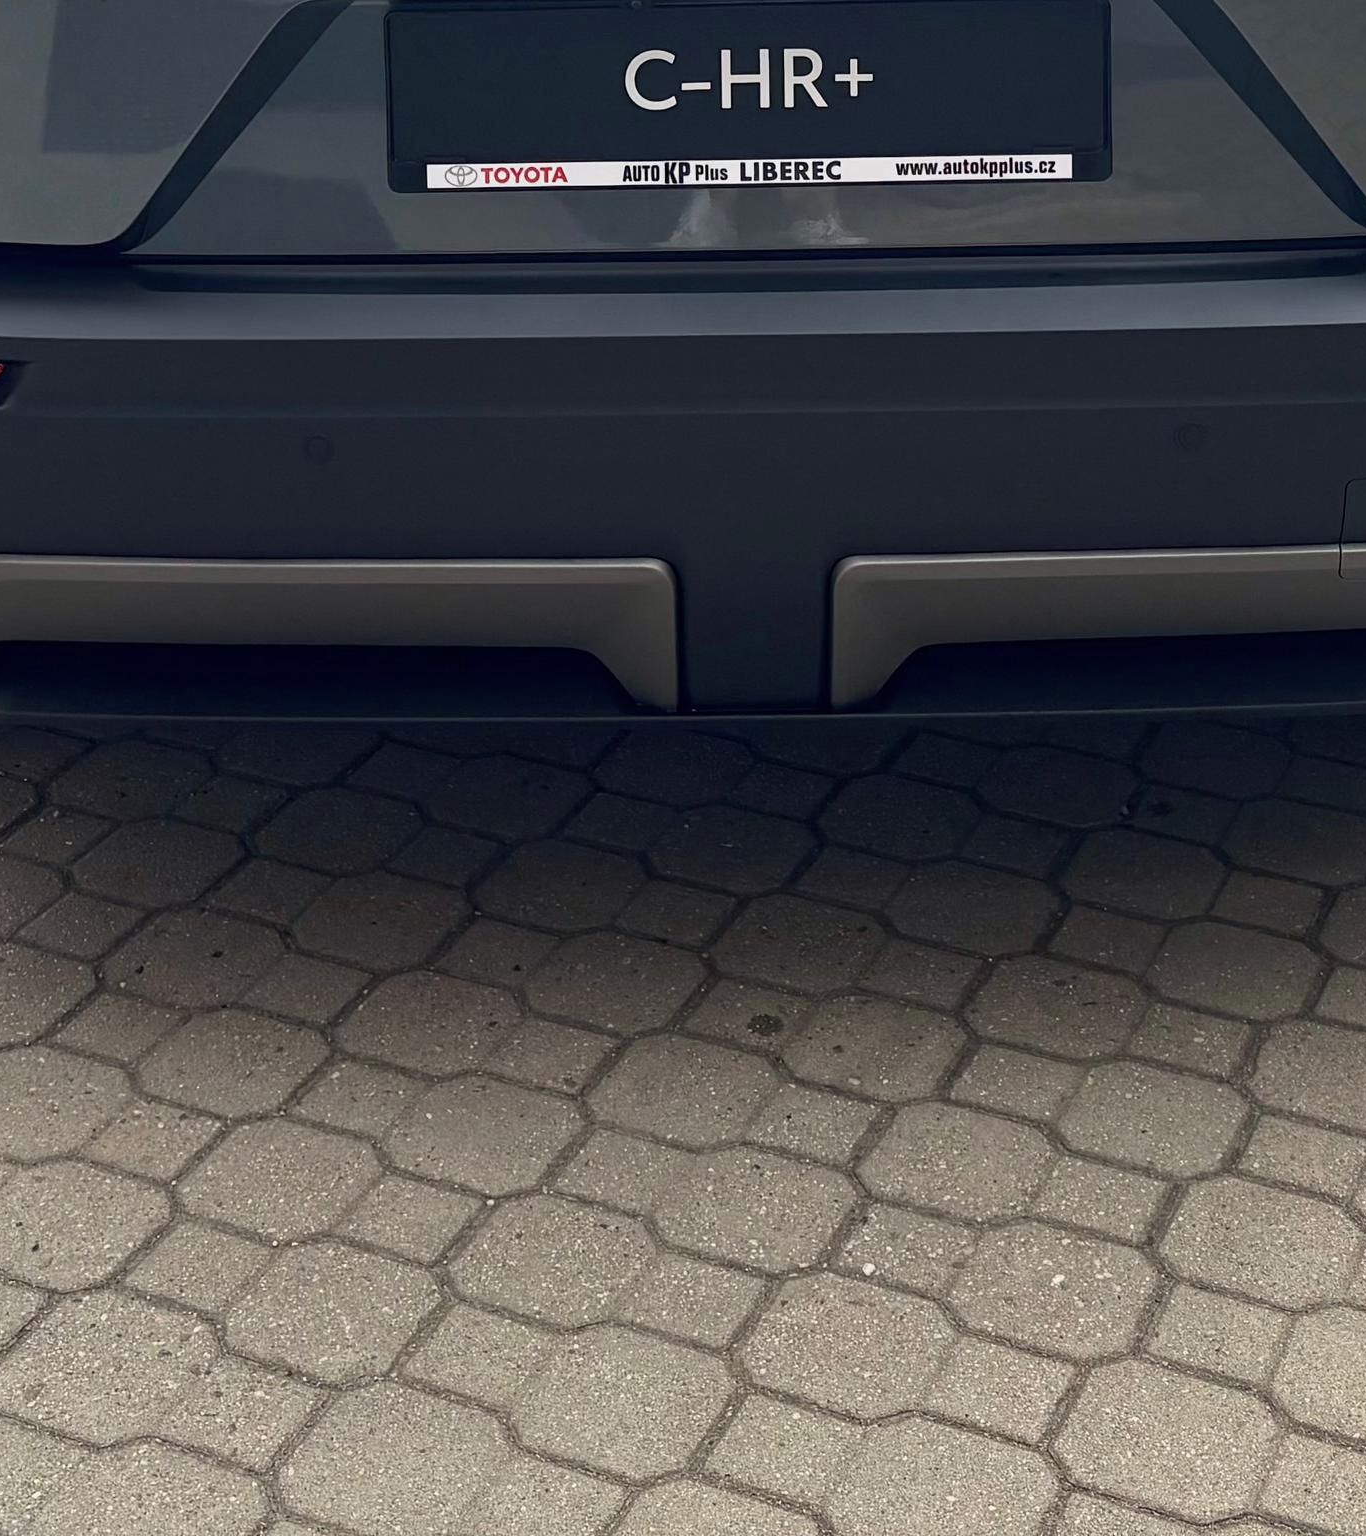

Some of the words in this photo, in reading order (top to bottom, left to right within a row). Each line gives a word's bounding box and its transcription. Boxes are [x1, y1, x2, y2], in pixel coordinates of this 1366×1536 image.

[624, 48, 874, 111] C-HR+
[481, 166, 569, 185] TOYOTA
[622, 165, 660, 183] AUTO
[664, 162, 691, 184] KP
[695, 164, 729, 182] Plus
[739, 161, 842, 182] LIBEREC
[895, 157, 1056, 178] www.autokpplus.cz
